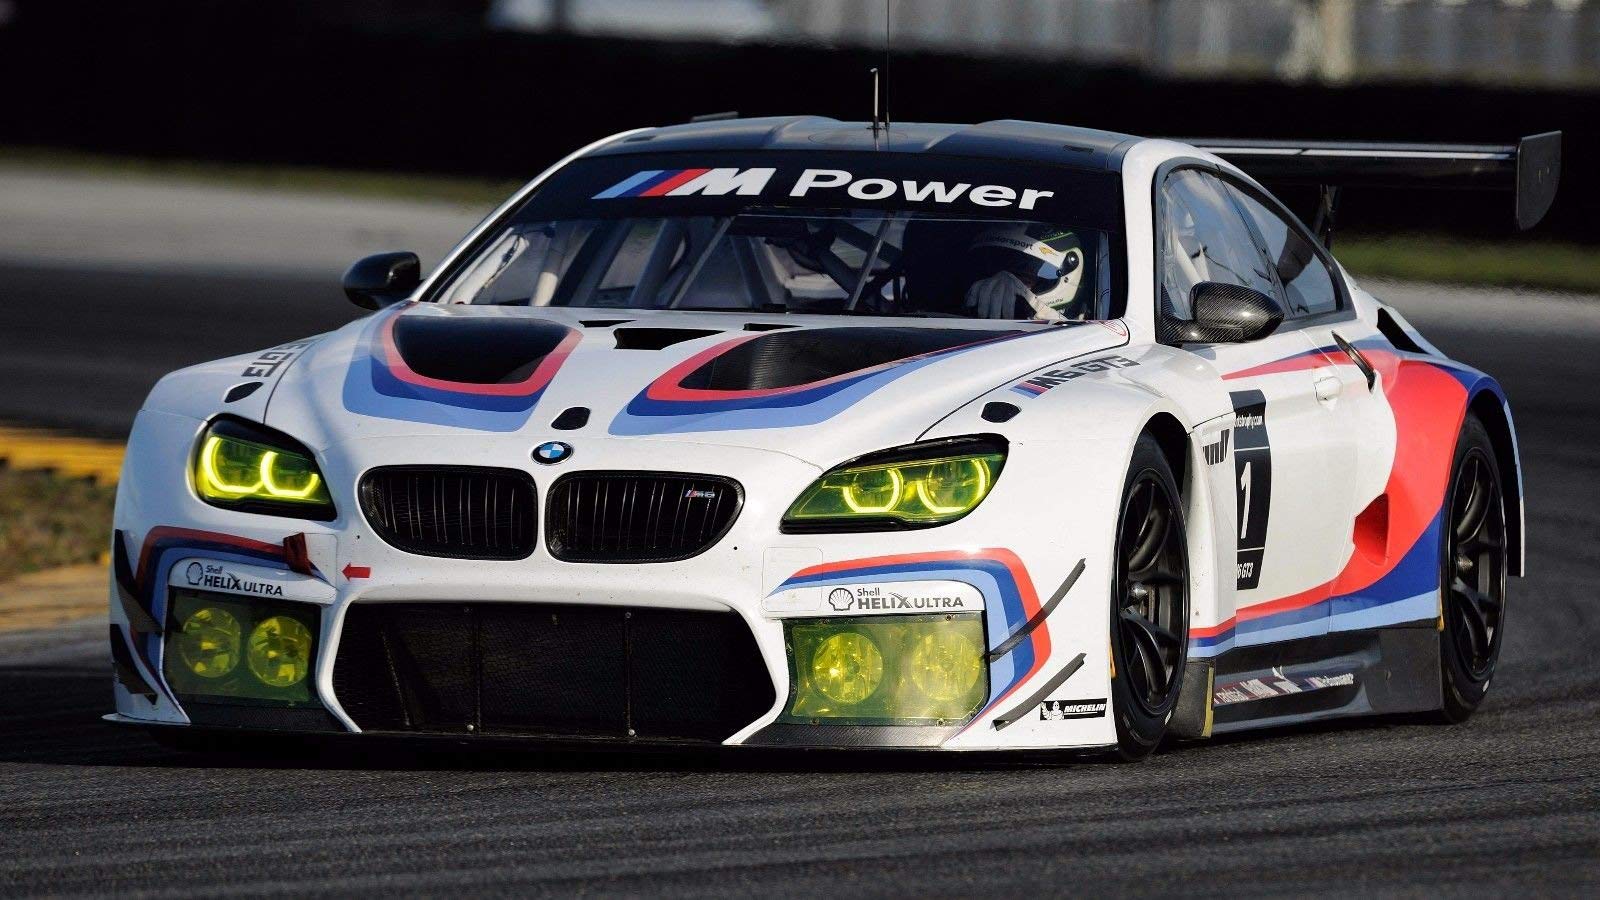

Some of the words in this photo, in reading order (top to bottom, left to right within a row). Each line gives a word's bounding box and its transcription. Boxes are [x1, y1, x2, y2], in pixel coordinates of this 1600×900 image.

[665, 167, 777, 197] M
[790, 168, 1054, 210] Power
[1070, 355, 1141, 373] GT3
[1240, 461, 1251, 540] 1
[206, 565, 223, 575] Shell
[1241, 562, 1254, 579] GT3
[204, 574, 241, 591] HELIX
[243, 581, 283, 597] ULTRA
[857, 587, 880, 597] Shell
[857, 596, 912, 610] HELIX
[914, 597, 964, 609] ULTRA
[1063, 703, 1106, 713] MICHELIN
